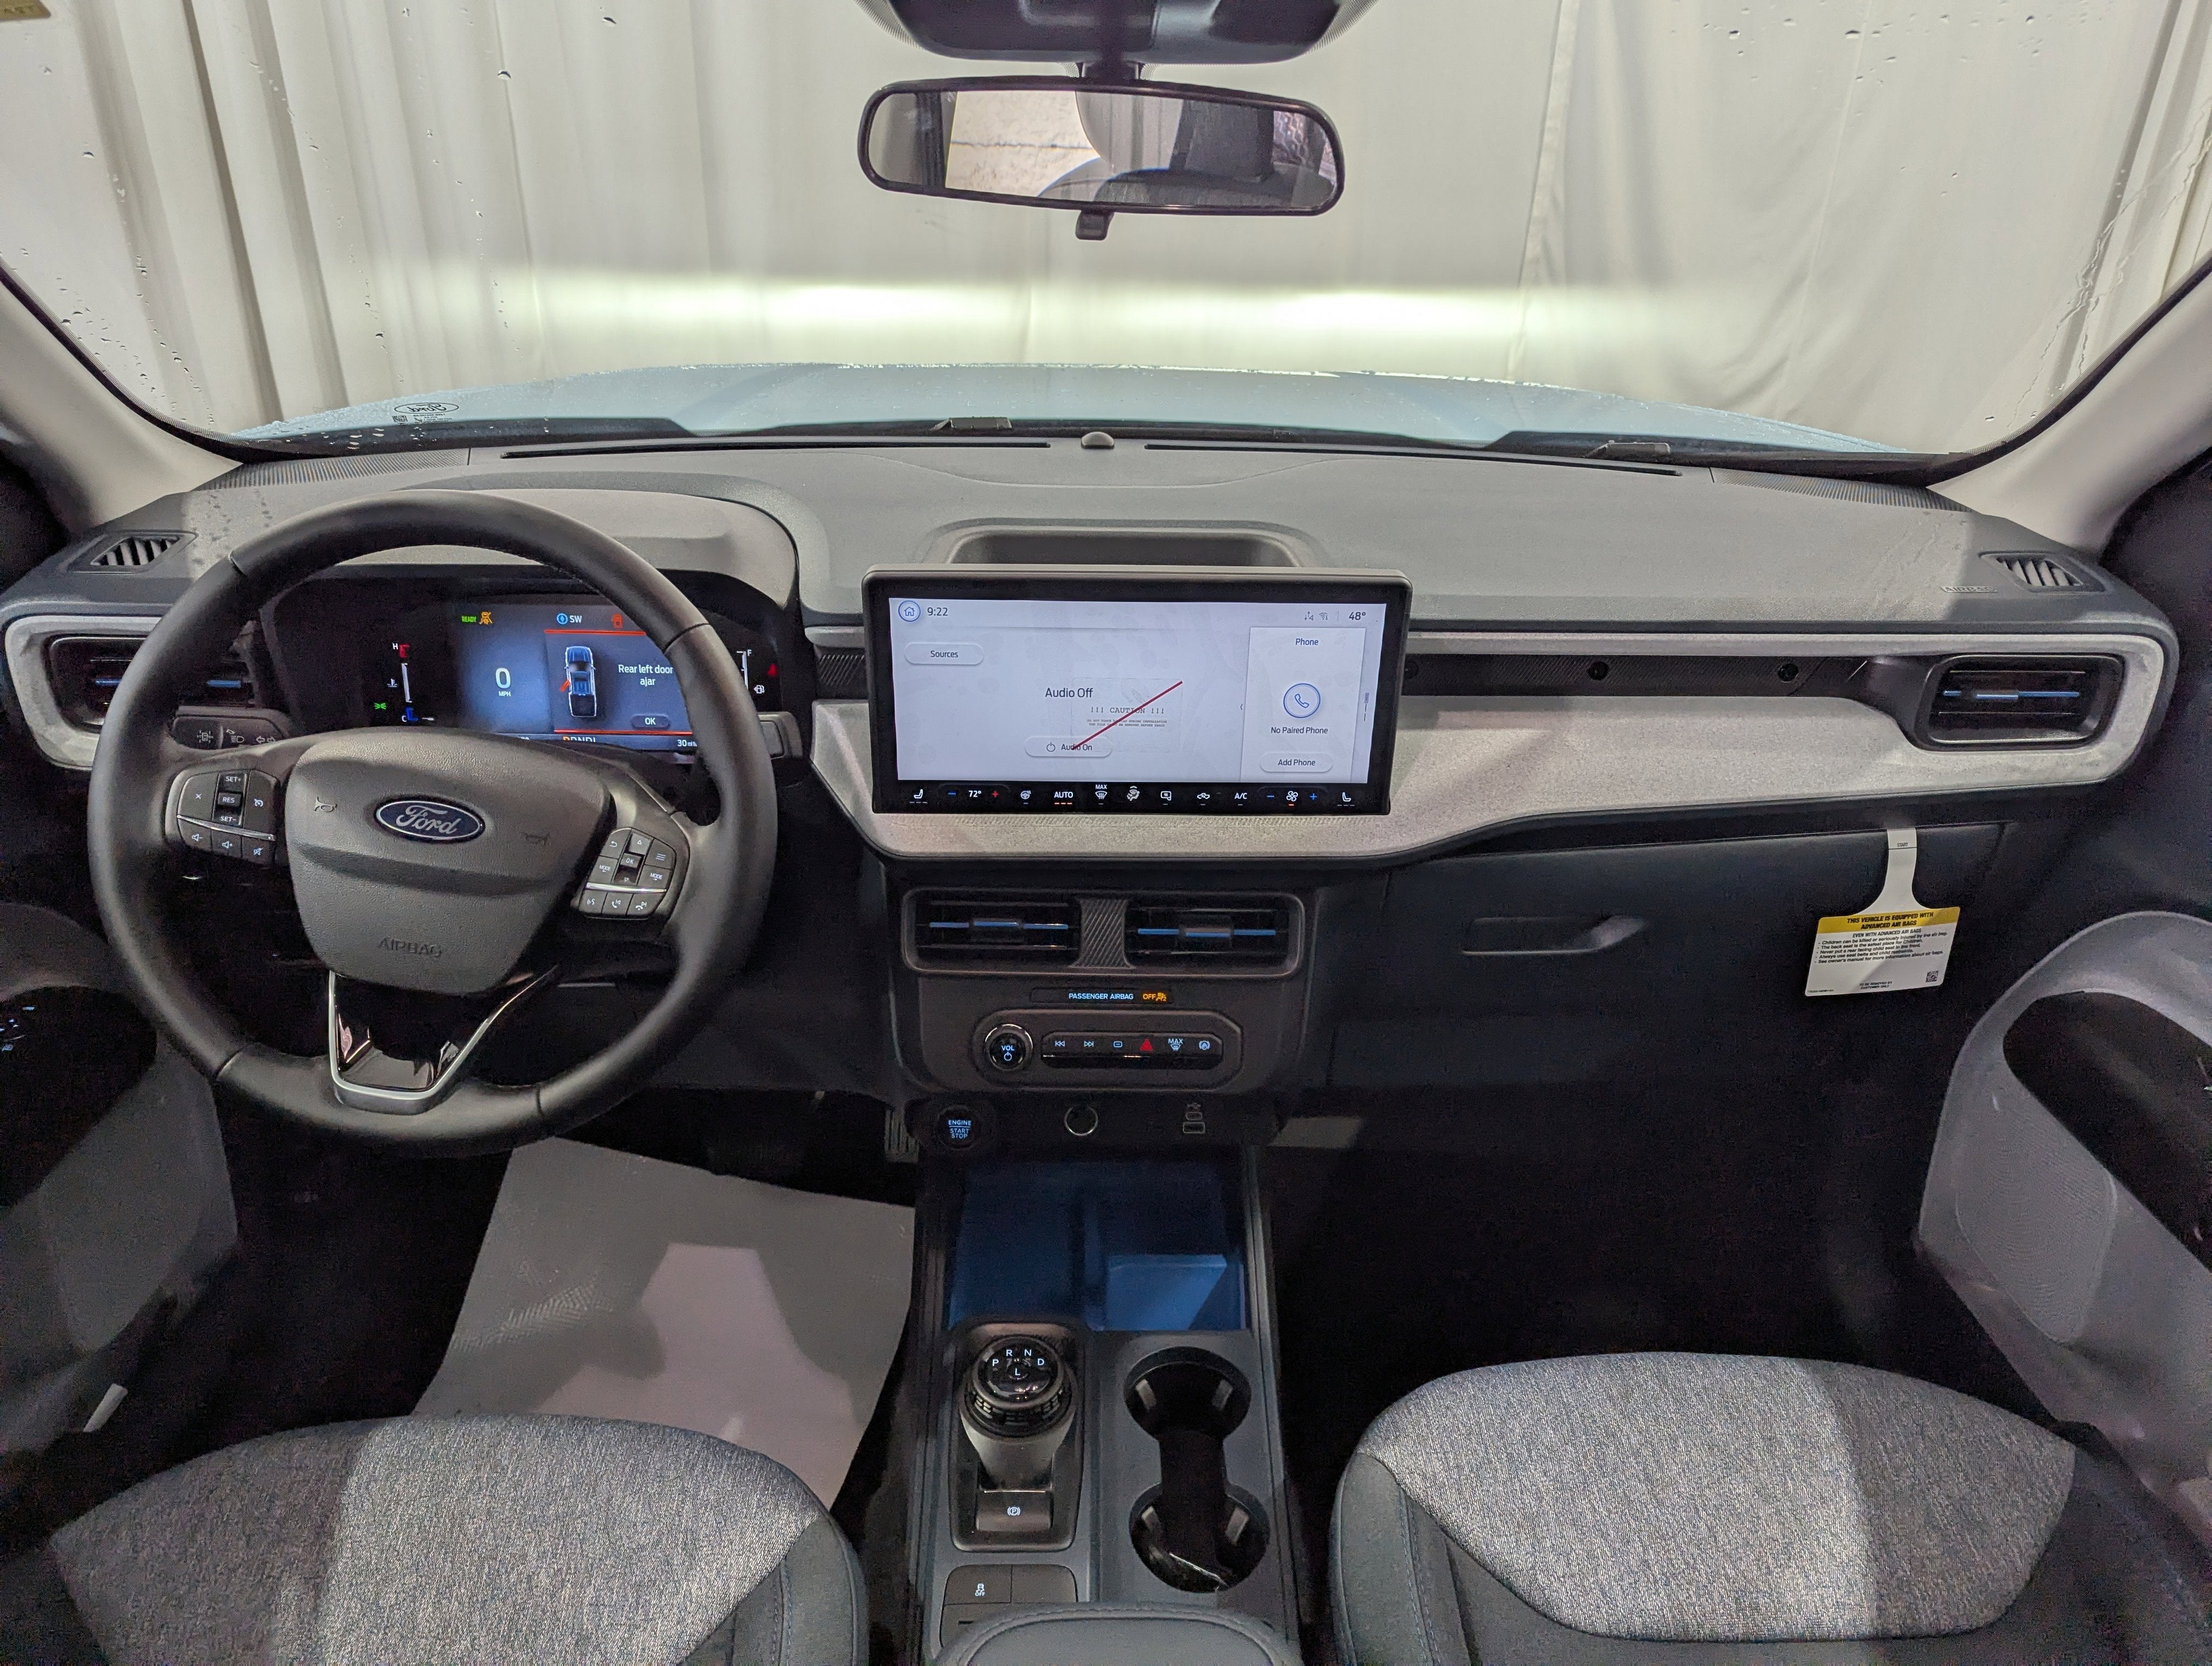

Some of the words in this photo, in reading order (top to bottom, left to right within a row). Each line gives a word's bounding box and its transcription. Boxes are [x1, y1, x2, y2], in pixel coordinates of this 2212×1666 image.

[927, 607, 948, 617] 9:22
[1348, 611, 1366, 621] 48°
[930, 650, 959, 658] Sources
[618, 664, 638, 673] Rear
[639, 664, 653, 674] left
[654, 665, 673, 674] door
[496, 668, 511, 688] 0
[640, 677, 655, 686] ajar
[1045, 688, 1075, 698] Audio
[1077, 687, 1093, 698] Off
[1282, 726, 1304, 734] Paired
[396, 805, 461, 835] Ford
[992, 1359, 999, 1367] P
[1015, 1368, 1020, 1376] L
